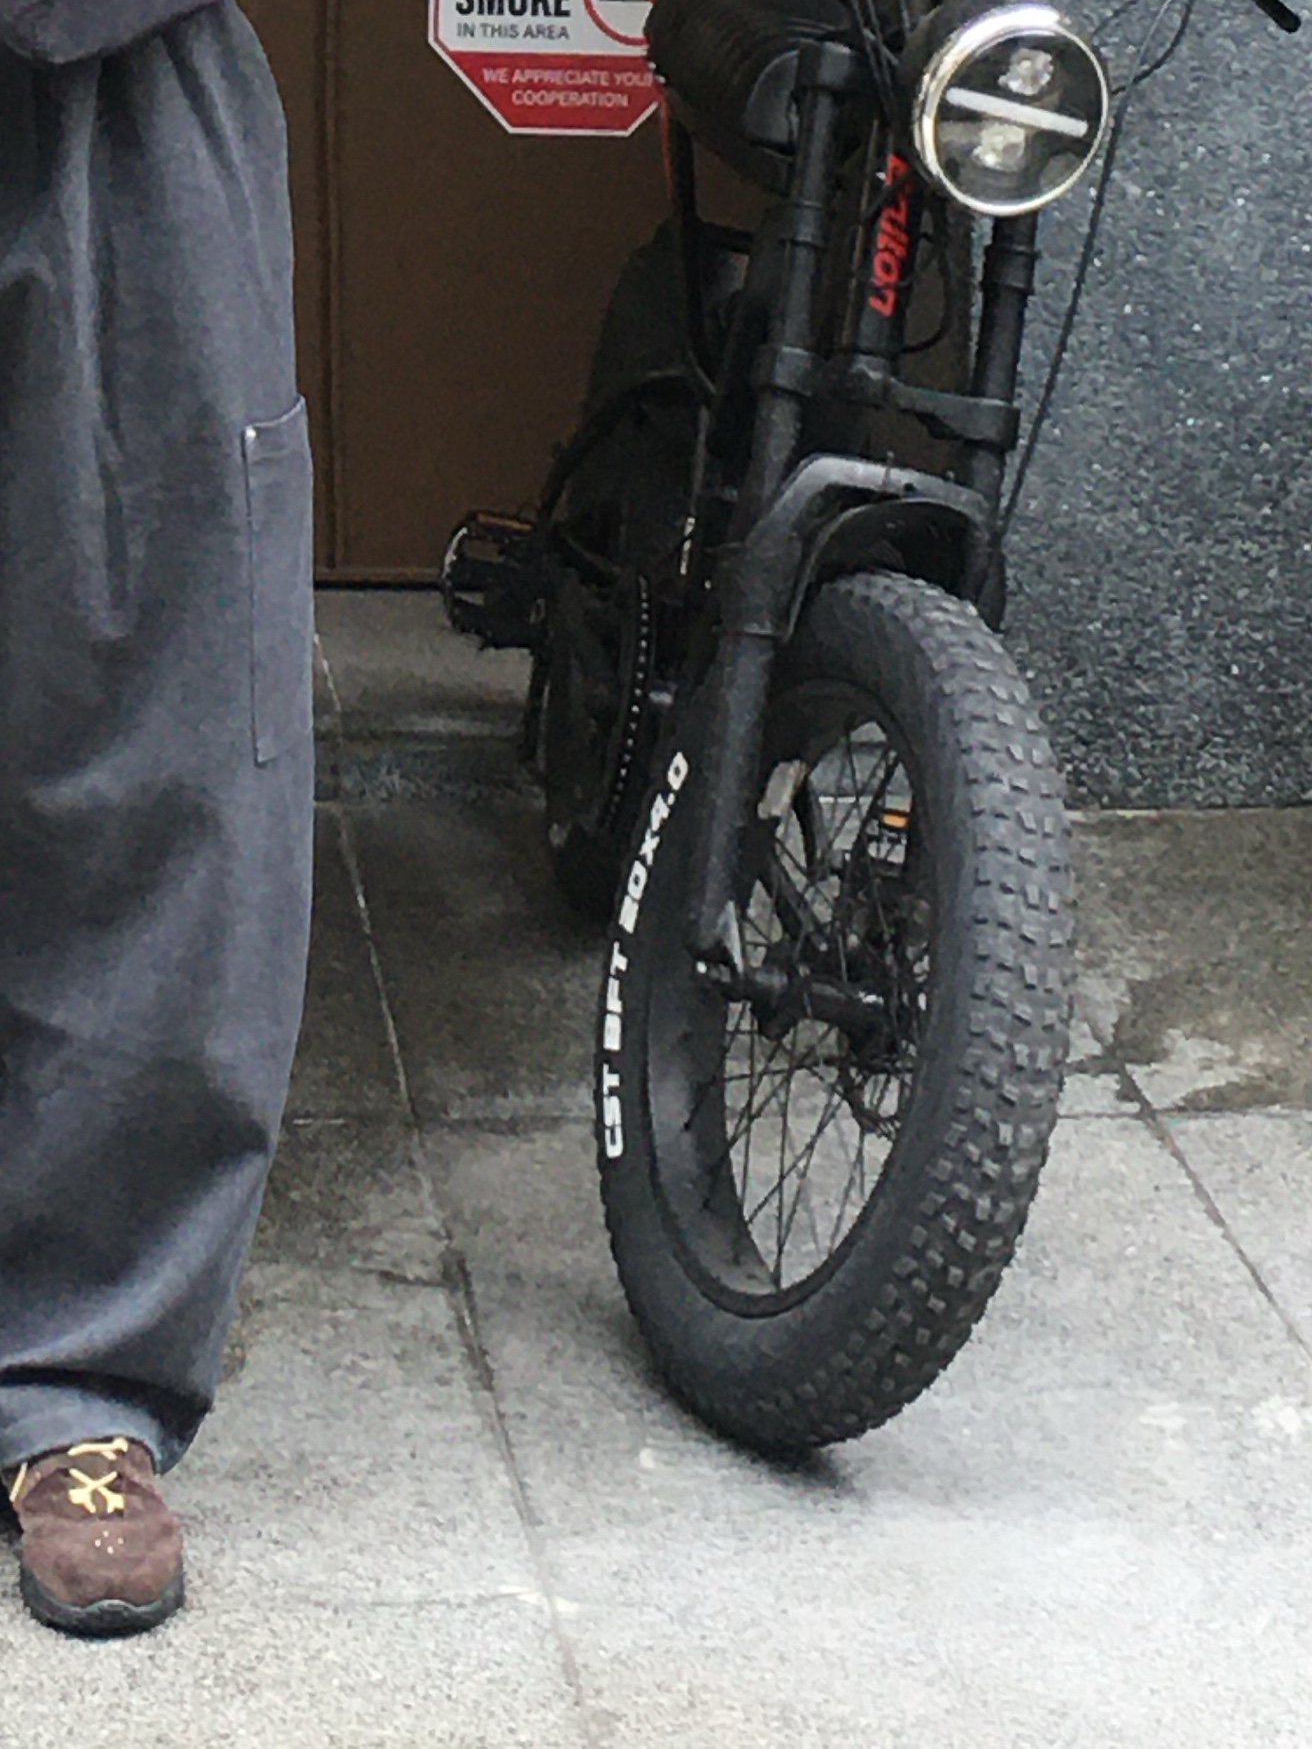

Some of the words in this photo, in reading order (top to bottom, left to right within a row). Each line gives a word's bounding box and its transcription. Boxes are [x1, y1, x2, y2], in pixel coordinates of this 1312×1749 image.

[456, 22, 475, 39] IN
[481, 23, 519, 40] THIS
[522, 24, 570, 40] AREA
[482, 67, 509, 84] WE
[512, 67, 610, 86] APPRECIATE
[511, 89, 628, 108] COOPERATION
[602, 940, 628, 1051] BFT
[602, 1063, 624, 1158] CST
